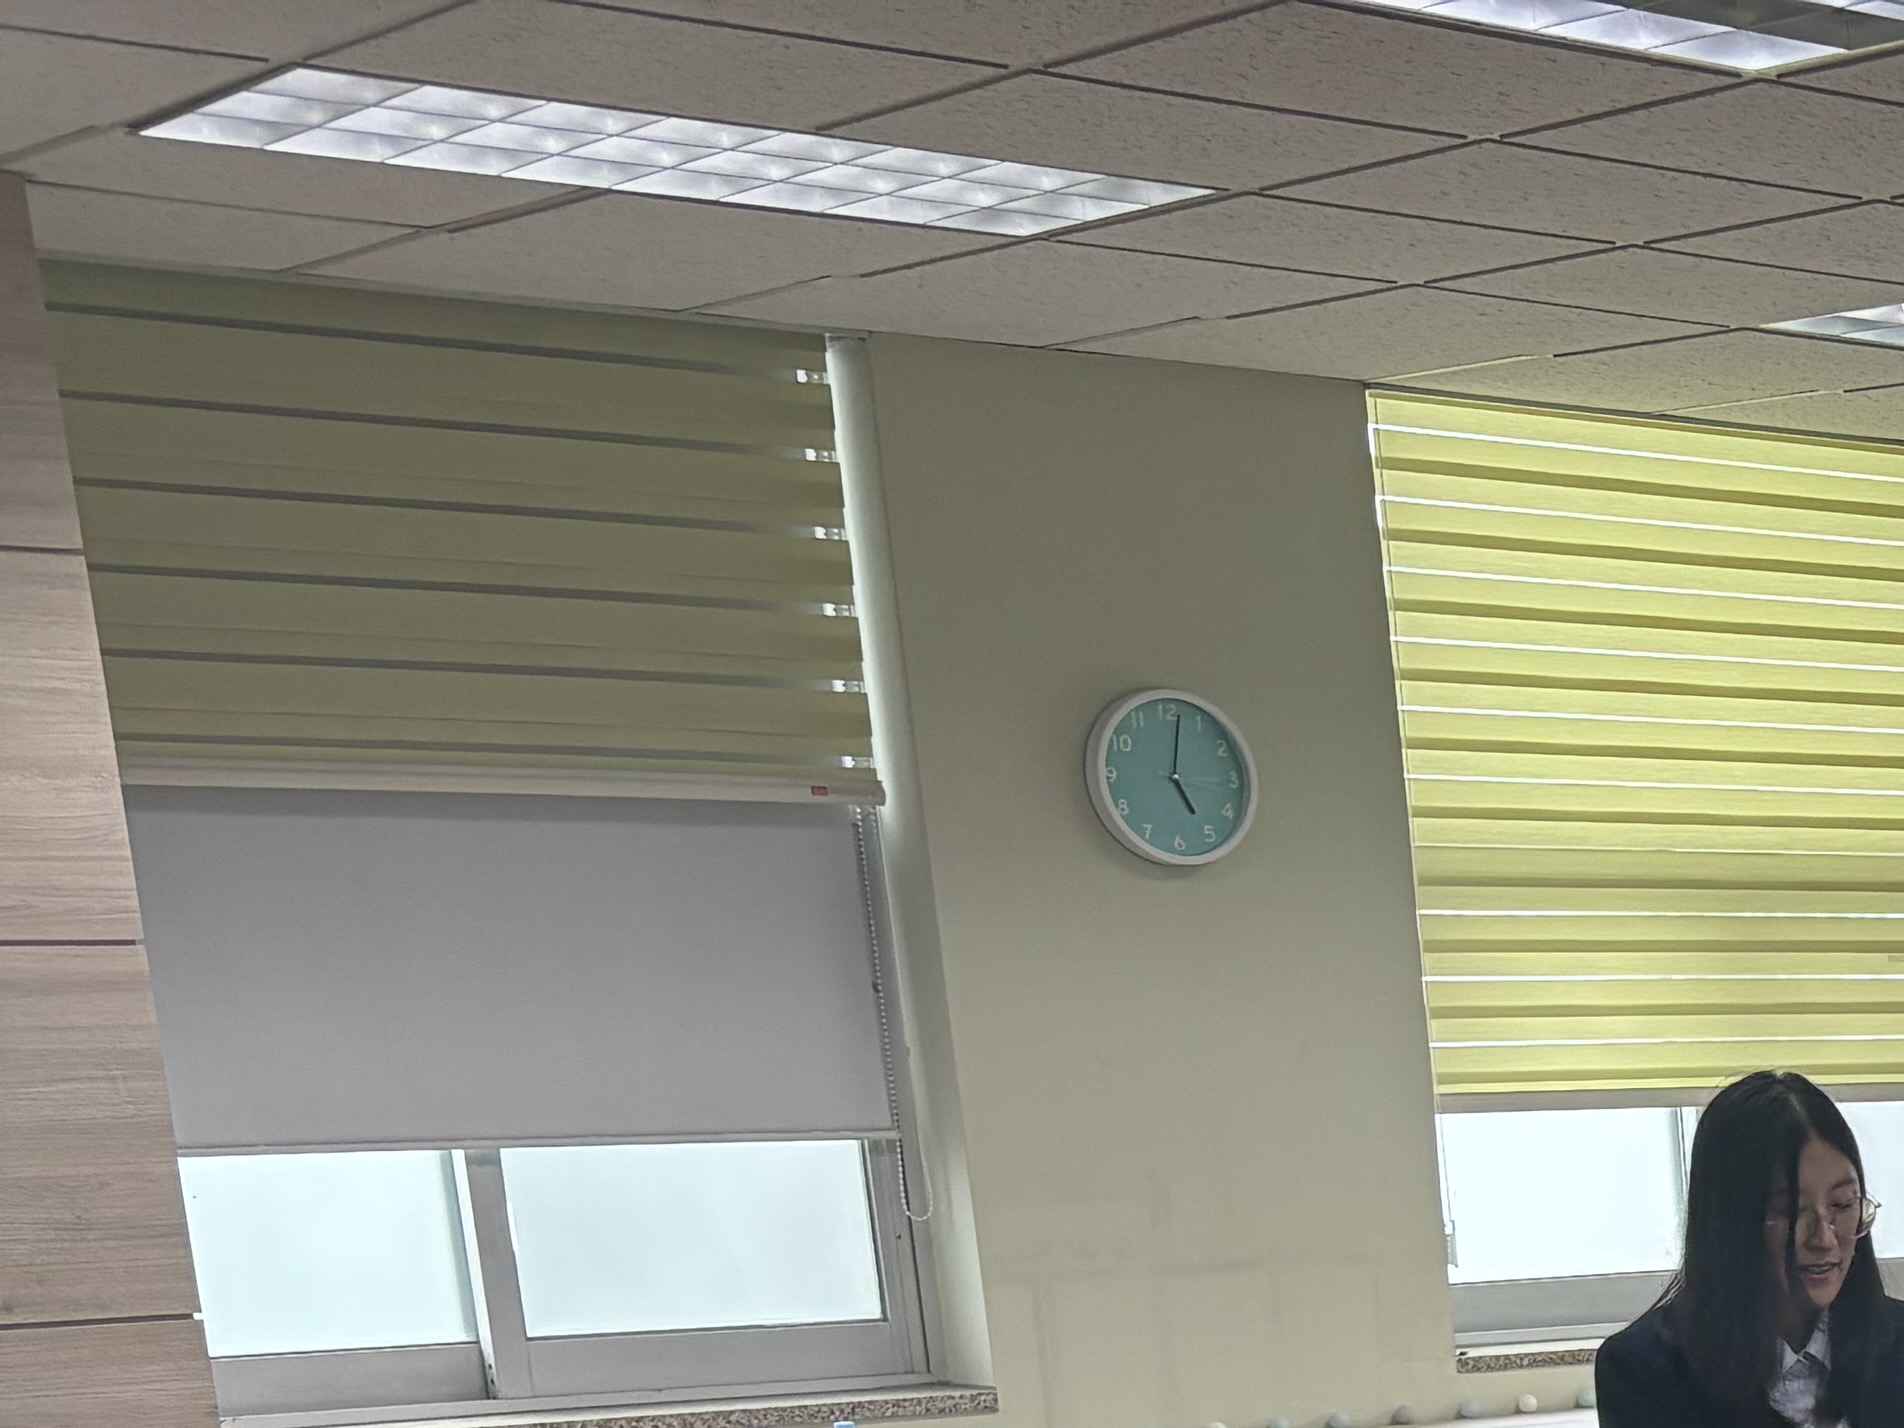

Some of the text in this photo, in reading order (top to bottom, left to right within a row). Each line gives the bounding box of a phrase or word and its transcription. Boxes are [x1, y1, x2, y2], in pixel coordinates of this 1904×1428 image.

[1130, 711, 1144, 728] 11
[1158, 703, 1177, 720] 12
[1113, 734, 1131, 752] 10
[1217, 740, 1228, 757] 2
[1229, 771, 1239, 788] 3
[1118, 799, 1129, 815] 8
[1222, 803, 1233, 819] 4
[1142, 824, 1152, 839] 7
[1204, 825, 1216, 842] 5
[1174, 835, 1186, 850] 6
